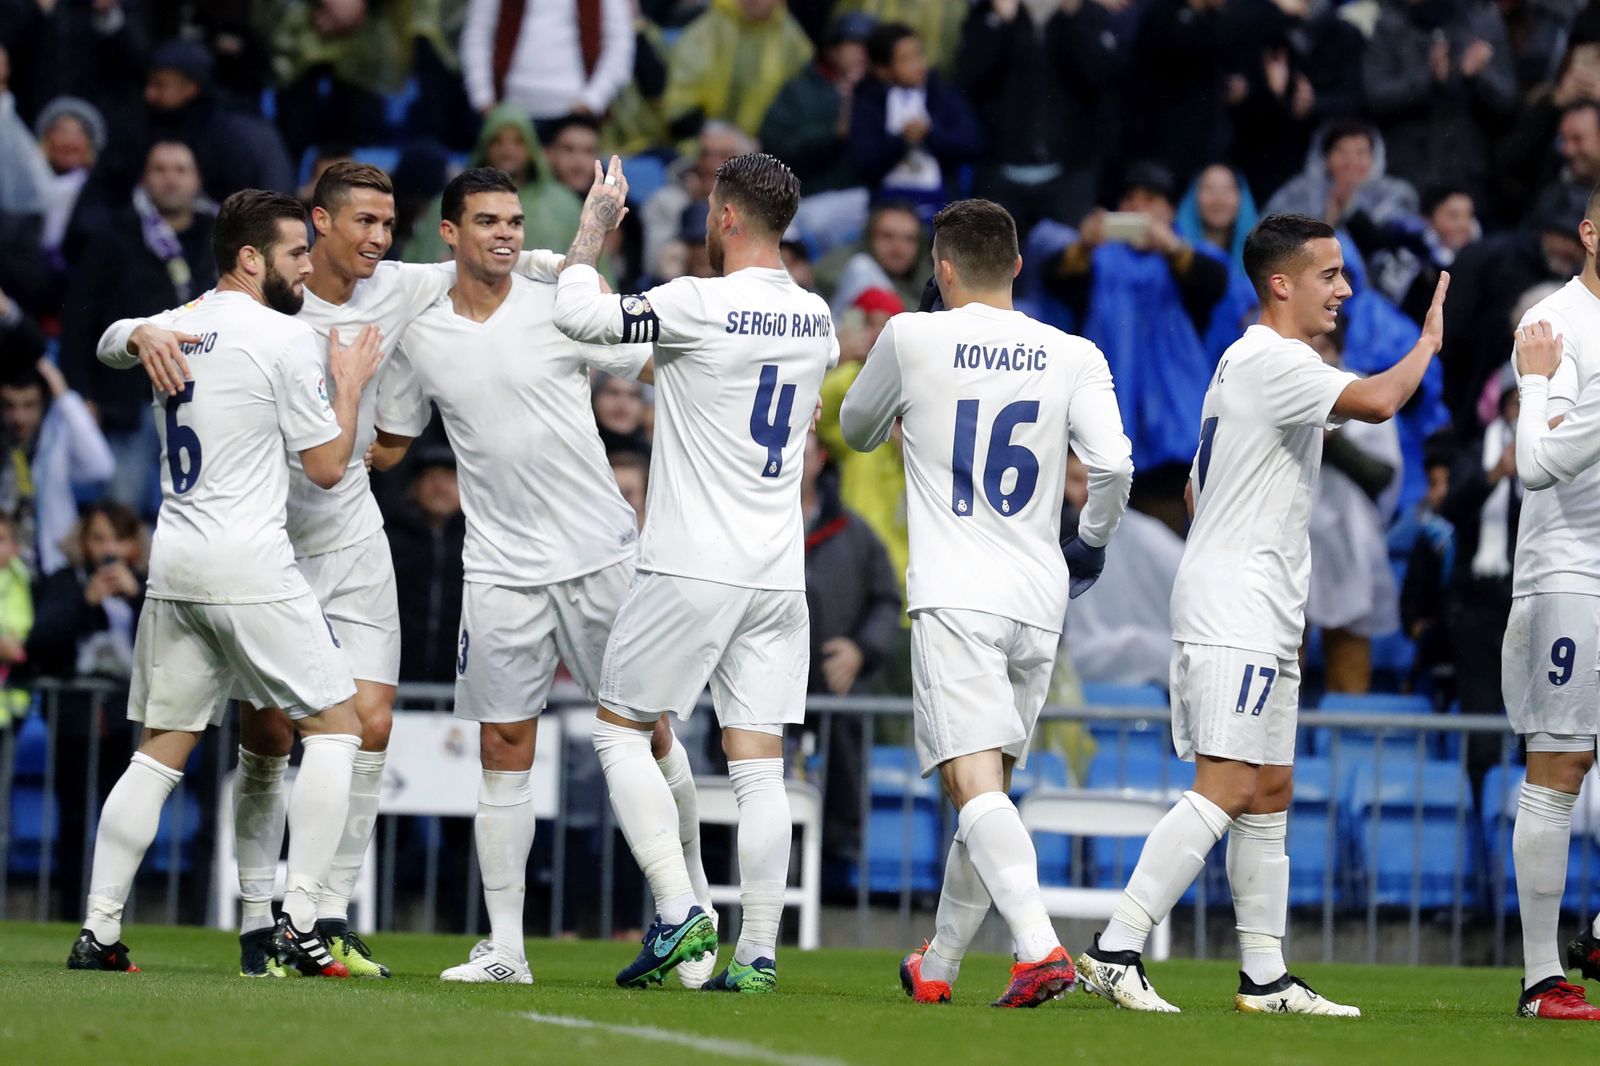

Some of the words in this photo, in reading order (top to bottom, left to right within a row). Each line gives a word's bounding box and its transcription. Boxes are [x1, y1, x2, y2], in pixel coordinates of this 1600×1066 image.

[791, 313, 830, 337] RAMOS
[166, 381, 203, 494] 6
[750, 365, 797, 478] 4
[952, 399, 1040, 517] 16
[457, 628, 469, 675] 3
[1548, 636, 1576, 686] 9
[1235, 664, 1276, 716] 17
